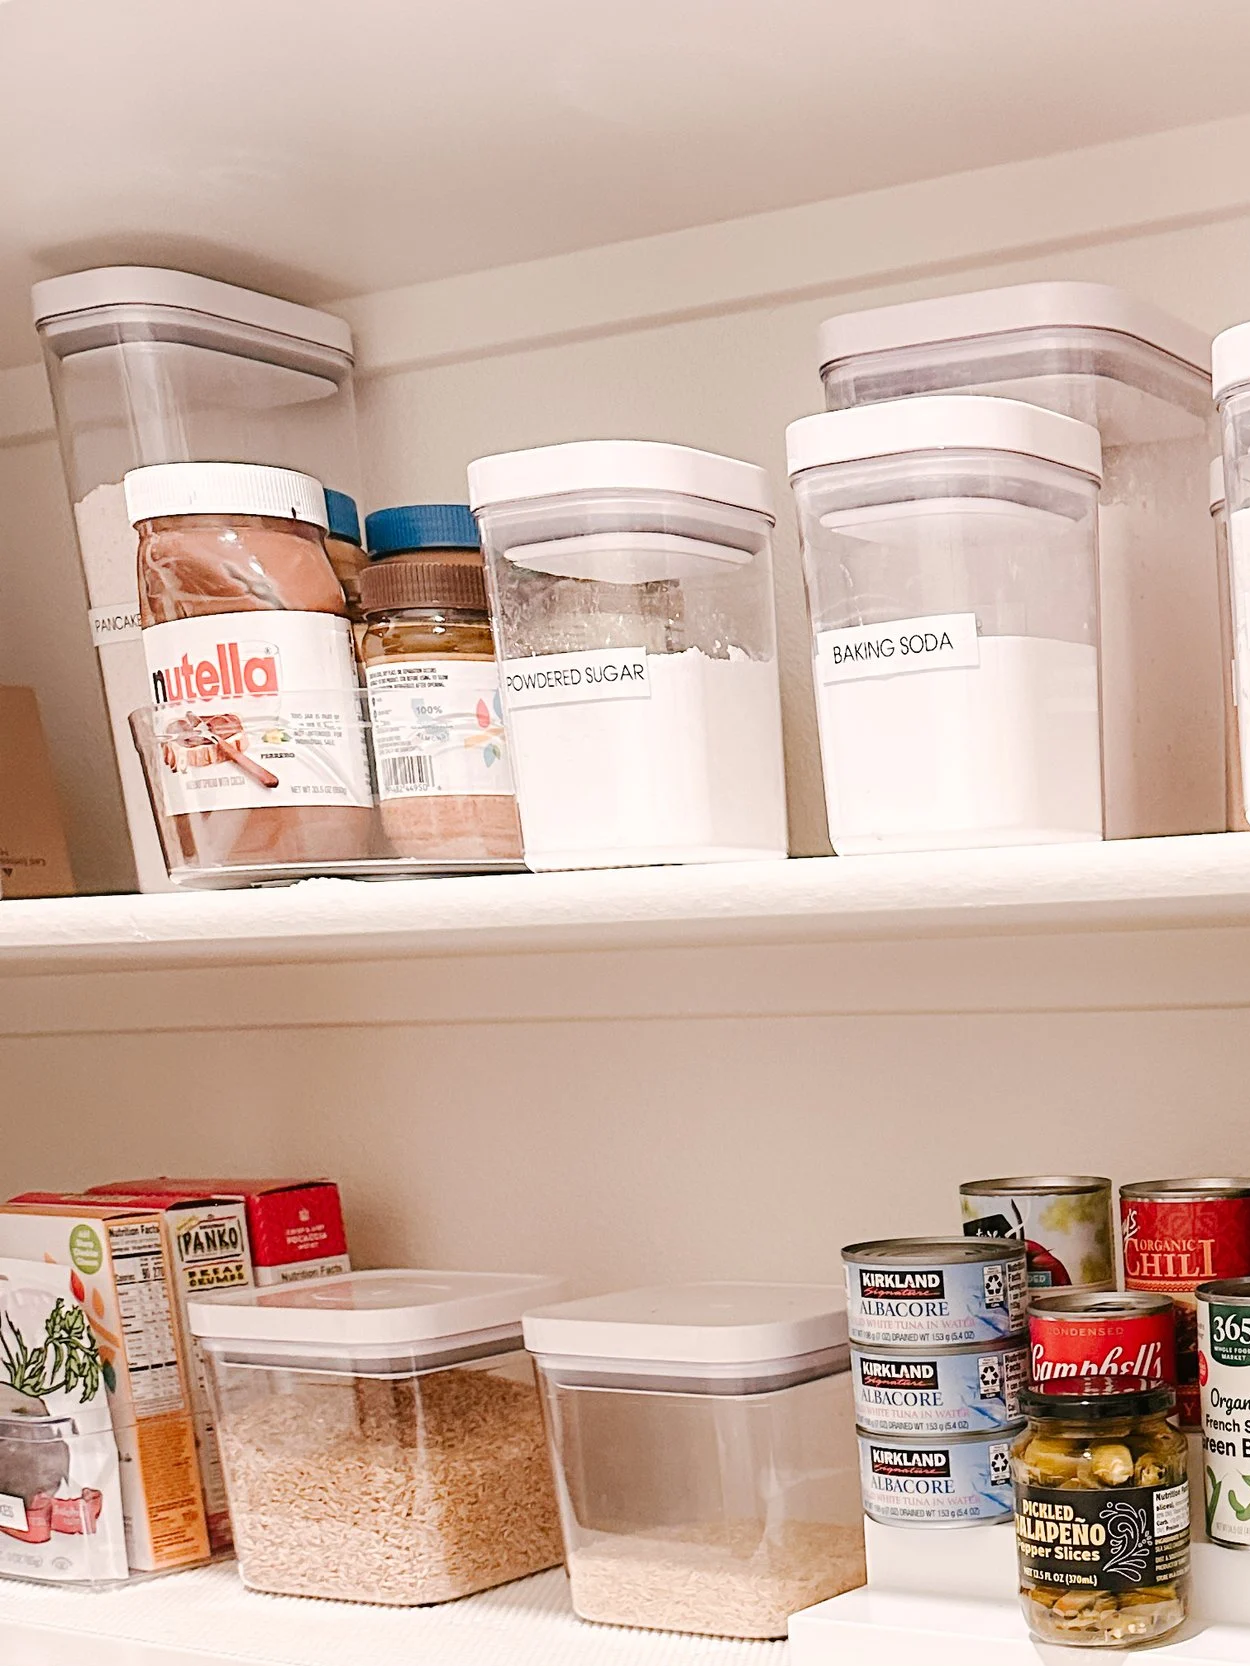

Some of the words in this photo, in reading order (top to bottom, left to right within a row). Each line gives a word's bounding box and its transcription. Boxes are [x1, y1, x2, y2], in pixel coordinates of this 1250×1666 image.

[832, 639, 895, 665] BAKING
[899, 632, 954, 656] SODA
[152, 642, 279, 704] nutella
[585, 663, 645, 685] SUGAR
[416, 706, 442, 715] 100%
[109, 1227, 138, 1238] Nutrition
[140, 1224, 160, 1235] Facts
[183, 1228, 238, 1256] PANKO
[1140, 1240, 1194, 1251] ORGANIC
[188, 1264, 243, 1278] BREAD
[189, 1273, 244, 1287] CRUMBS
[862, 1272, 940, 1289] KIRKLAND
[864, 1287, 940, 1297] Signature
[860, 1300, 949, 1318] ALBACORE
[866, 1318, 896, 1328] WHITE
[897, 1319, 923, 1330] TUNA
[925, 1320, 935, 1330] IN
[942, 1316, 976, 1330] WATER
[1046, 1326, 1124, 1337] CONDENSED
[1214, 1345, 1232, 1354] WHOLE
[1221, 1353, 1246, 1361] MARKET
[862, 1362, 934, 1379] KIRKLAND
[864, 1377, 934, 1387] Signature
[861, 1391, 943, 1407] ALBACORE
[867, 1407, 890, 1418] WHITE
[892, 1408, 918, 1418] TUNA
[921, 1408, 931, 1418] IN
[935, 1406, 969, 1418] WATER
[1206, 1414, 1240, 1433] French
[872, 1450, 946, 1467] KIRKLAND
[874, 1465, 946, 1474] Signature
[872, 1479, 955, 1494] ALBACORE
[877, 1495, 902, 1505] WHITE
[904, 1496, 930, 1505] TUNA
[933, 1496, 943, 1505] IN
[947, 1495, 980, 1505] WATER
[1156, 1490, 1181, 1501] Nutrition
[1022, 1499, 1074, 1522] PICKLED
[1054, 1546, 1100, 1562] Slices
[1053, 1571, 1064, 1583] OZ
[1065, 1573, 1098, 1587] (370mL)
